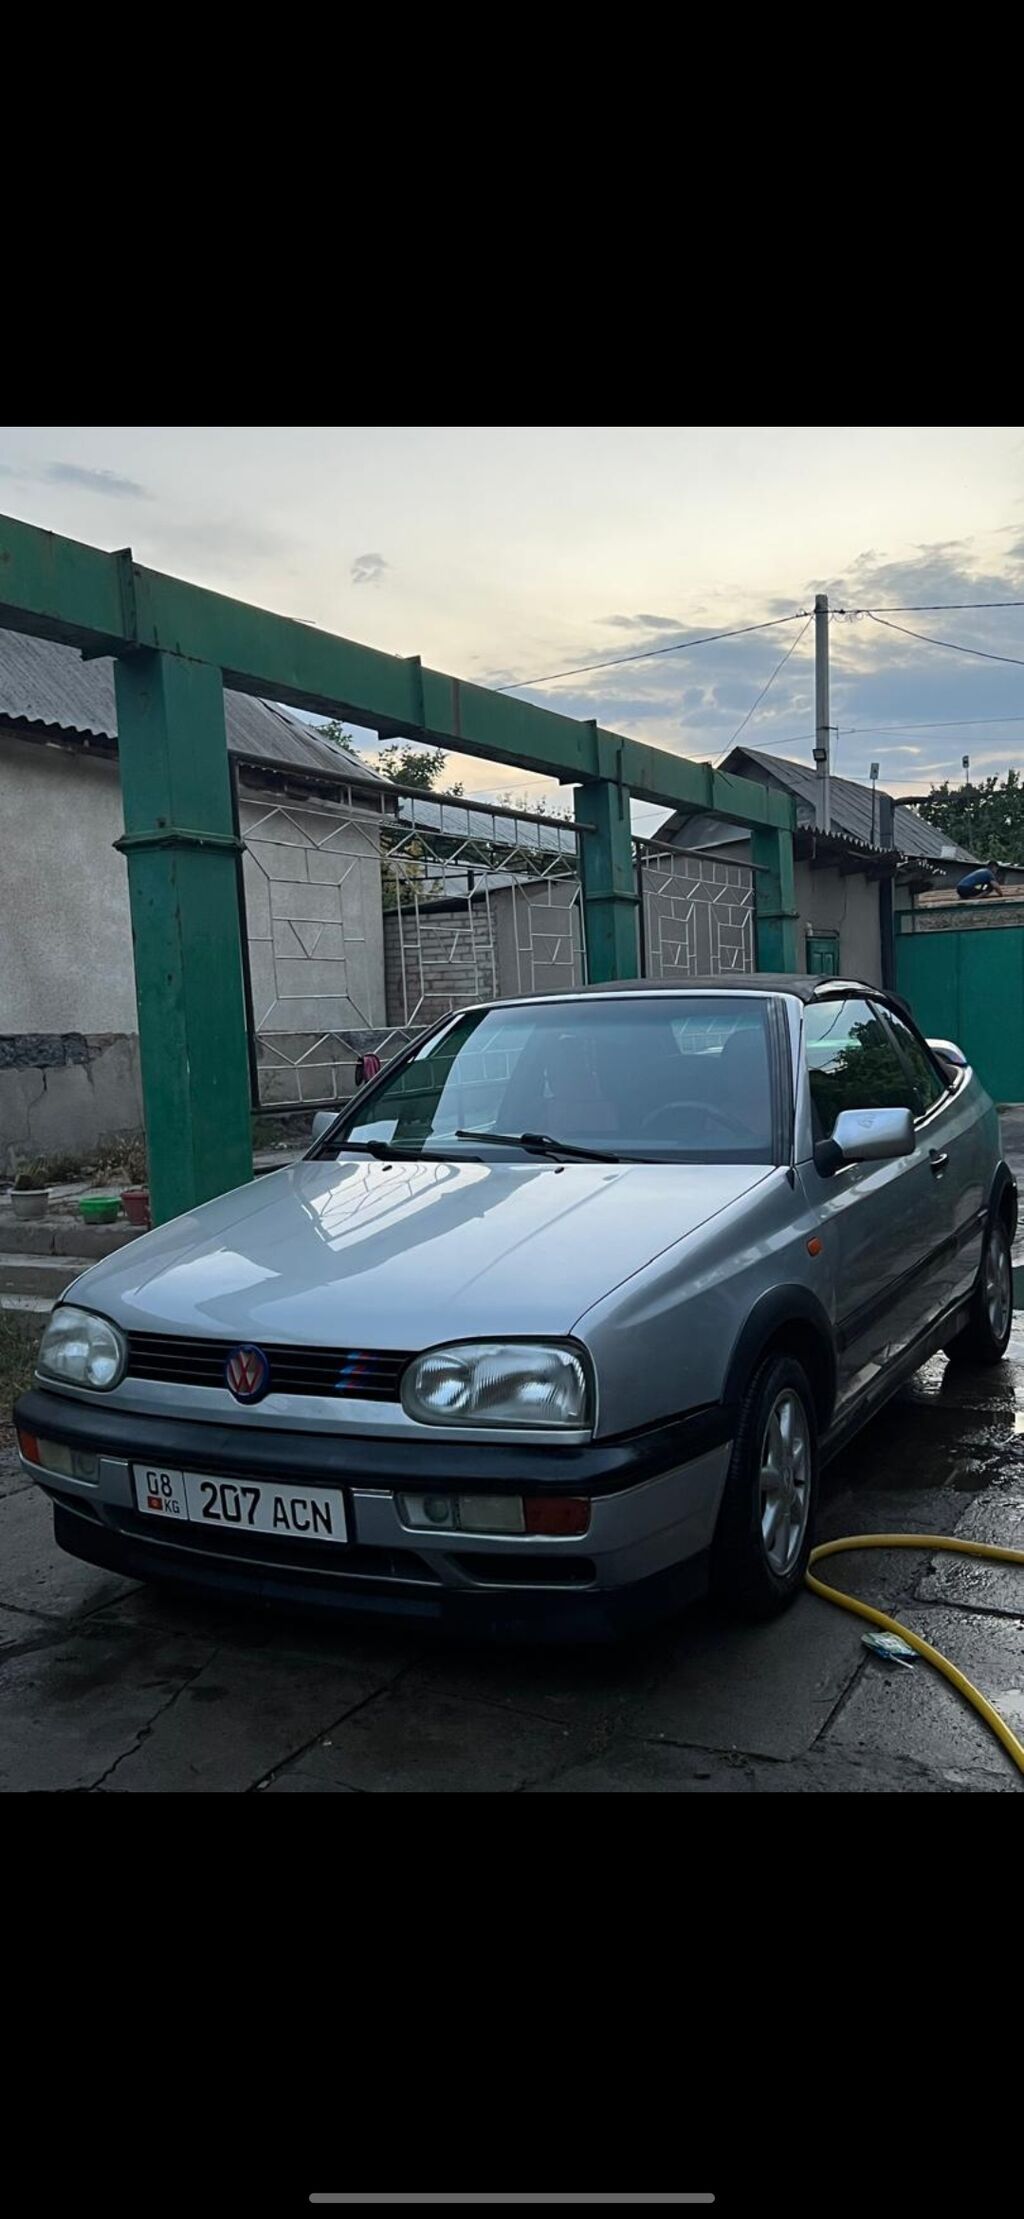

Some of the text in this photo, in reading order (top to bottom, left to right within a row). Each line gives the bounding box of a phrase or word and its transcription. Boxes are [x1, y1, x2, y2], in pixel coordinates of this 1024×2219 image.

[146, 1471, 334, 1534] 08 207 ACN
[164, 1499, 181, 1514] KG
